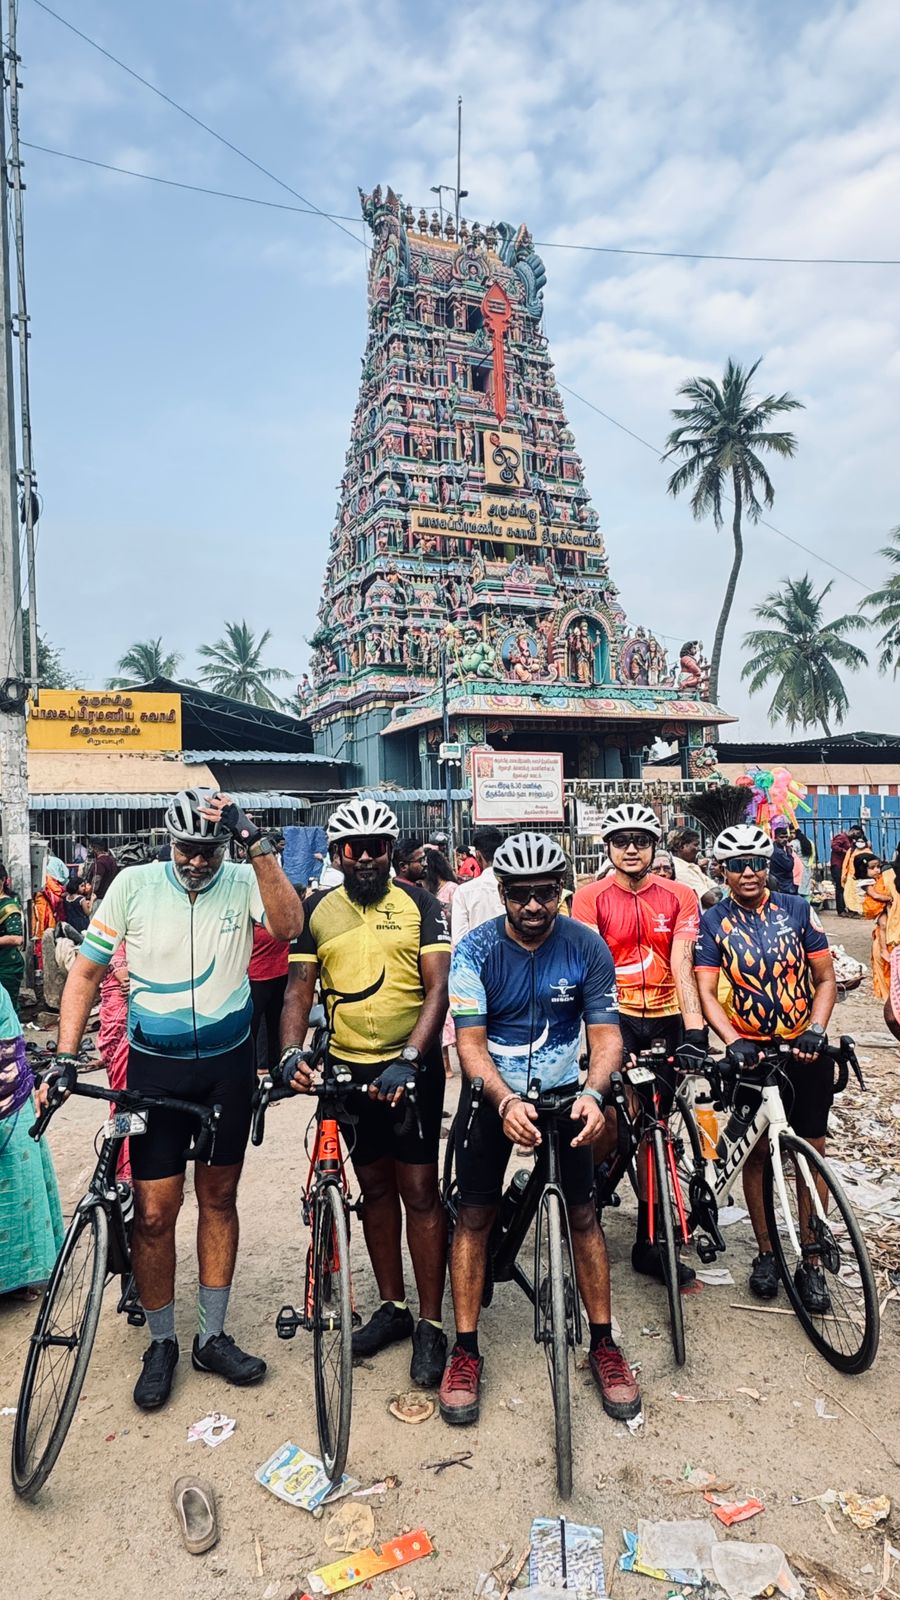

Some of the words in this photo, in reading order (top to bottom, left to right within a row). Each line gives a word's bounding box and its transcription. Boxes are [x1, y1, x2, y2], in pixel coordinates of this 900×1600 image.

[487, 503, 537, 524] அருள்மிகு
[77, 694, 133, 709] அருள்மிகு
[31, 706, 135, 725] பாலசுப்பிரமணிய
[140, 709, 176, 724] சுவாமி
